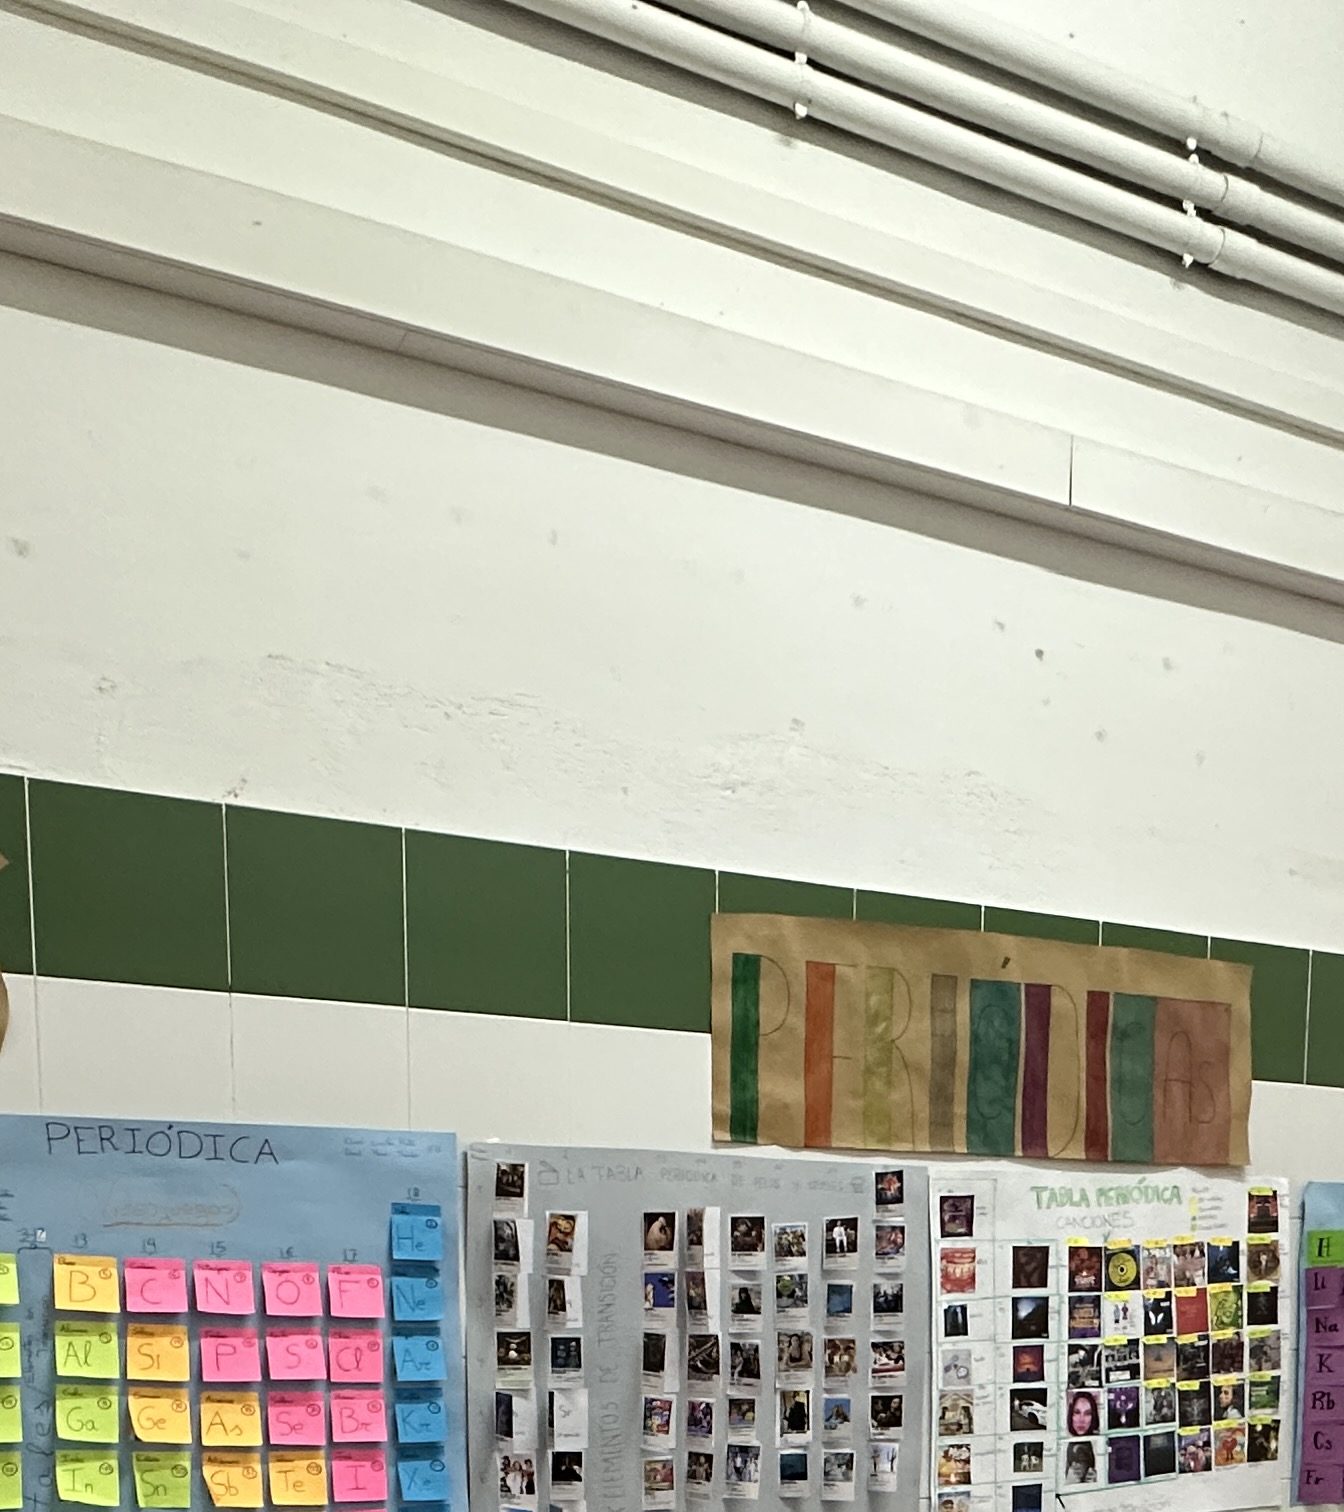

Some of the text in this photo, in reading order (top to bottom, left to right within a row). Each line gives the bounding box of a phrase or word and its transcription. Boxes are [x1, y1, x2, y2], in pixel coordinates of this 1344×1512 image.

[46, 1121, 280, 1165] PERIÓDICA
[1029, 1177, 1183, 1210] TABLA PERIÓDICA
[1056, 1210, 1136, 1230] CANCIONES
[211, 1241, 227, 1256] 15
[396, 1223, 425, 1252] He
[68, 1270, 97, 1304] B
[140, 1278, 163, 1305] C
[204, 1277, 231, 1306] N
[275, 1278, 301, 1306] O
[338, 1279, 362, 1310] F
[396, 1283, 427, 1313] Ne
[1314, 1316, 1340, 1334] Na
[63, 1340, 93, 1369] Al
[136, 1342, 162, 1371] Si
[215, 1342, 237, 1373] P
[285, 1344, 301, 1370] S
[335, 1346, 364, 1372] Cl
[1316, 1353, 1335, 1374] K
[1311, 1391, 1335, 1411] Rb
[66, 1406, 99, 1432] Ga
[137, 1405, 167, 1431] Ge
[205, 1411, 244, 1437] As
[276, 1411, 304, 1436] Se
[339, 1406, 372, 1435] Br
[1313, 1431, 1333, 1450] Cs
[61, 1467, 94, 1495] In
[141, 1469, 168, 1498] Sn
[210, 1470, 240, 1498] Sb
[276, 1469, 306, 1493] Te
[346, 1464, 366, 1491] I
[406, 1468, 432, 1491] Xe
[1305, 1469, 1325, 1485] Fr
